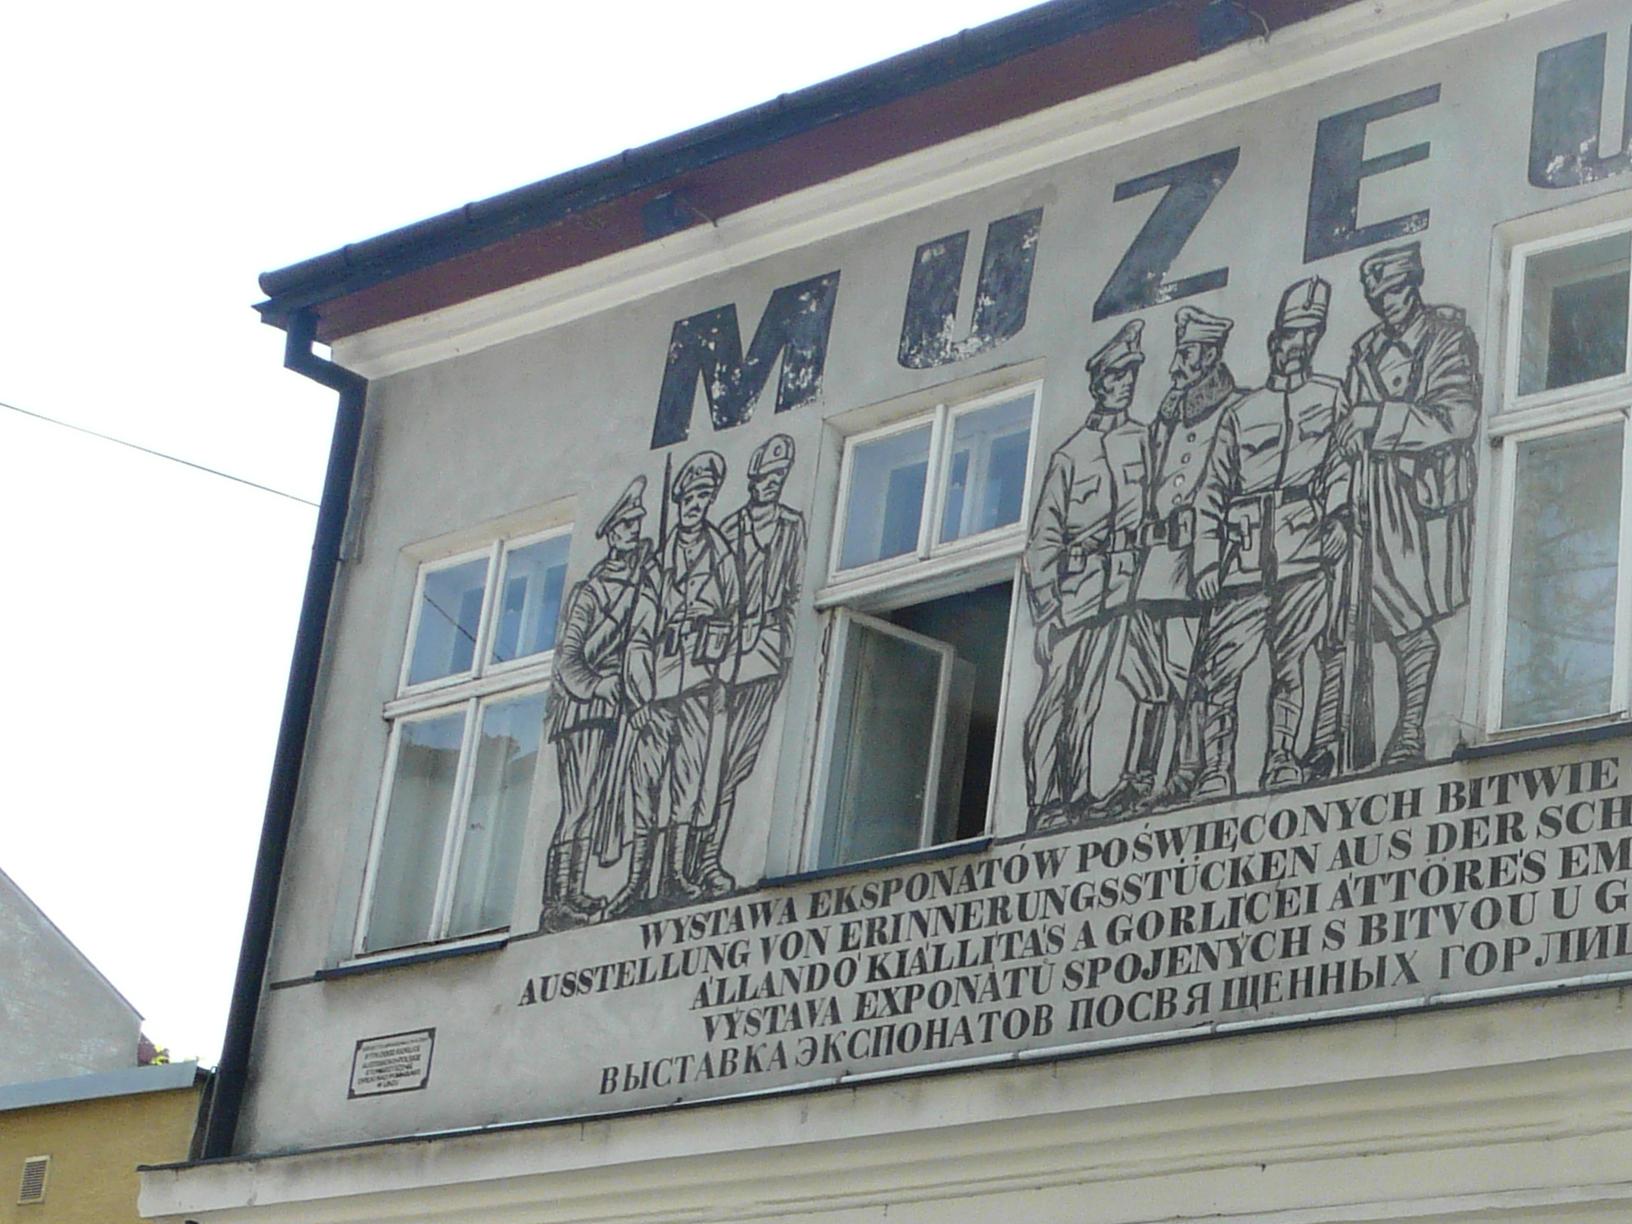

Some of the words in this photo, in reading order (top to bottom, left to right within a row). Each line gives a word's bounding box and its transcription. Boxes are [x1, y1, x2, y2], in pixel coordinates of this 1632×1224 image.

[518, 938, 750, 1007] AUSSTELLUNG
[759, 927, 827, 965] VON
[837, 843, 1322, 952] ERINNERUNGSSTÜCKEN
[1325, 829, 1413, 872] AUS
[1425, 811, 1528, 857] DER
[640, 892, 798, 951] WYSTAWA
[806, 843, 1075, 922] EKSPONATÓW
[1078, 786, 1423, 874] POŚWIĘCONYCH
[1437, 756, 1619, 814] BITWIE
[1072, 920, 1098, 951] A
[1105, 883, 1322, 947] GORLICEI
[1322, 918, 1347, 952] S
[1358, 891, 1536, 948] BITVOU
[1551, 884, 1582, 920] U
[600, 1038, 787, 1096] ВЫСТАВКА
[795, 1003, 1054, 1068] ЭКСПОНАТОВ
[1067, 949, 1421, 1031] ПОСВЯЩЕННЫХ
